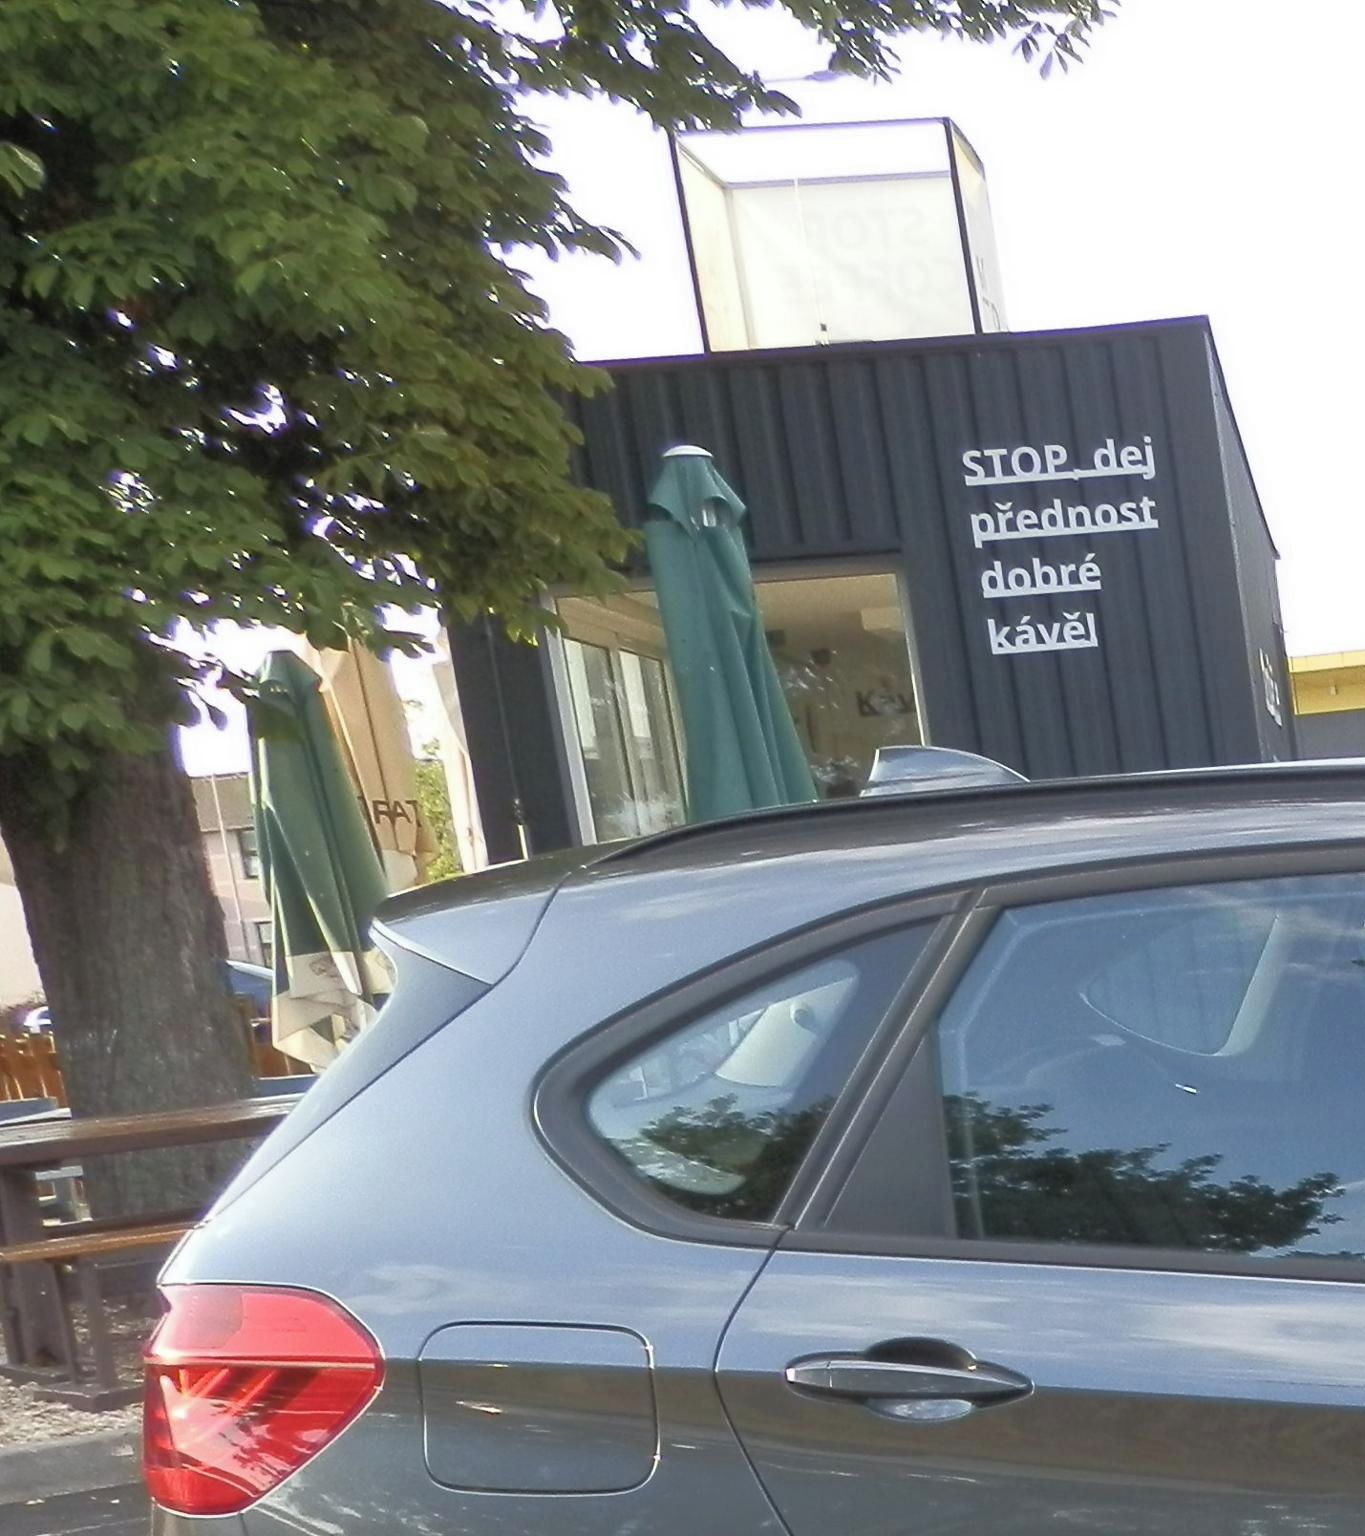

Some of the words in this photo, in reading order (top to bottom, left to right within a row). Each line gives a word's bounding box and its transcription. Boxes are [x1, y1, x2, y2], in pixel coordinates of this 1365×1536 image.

[1094, 436, 1156, 480] dej
[970, 496, 1159, 548] přednost
[981, 553, 1101, 598] dobré
